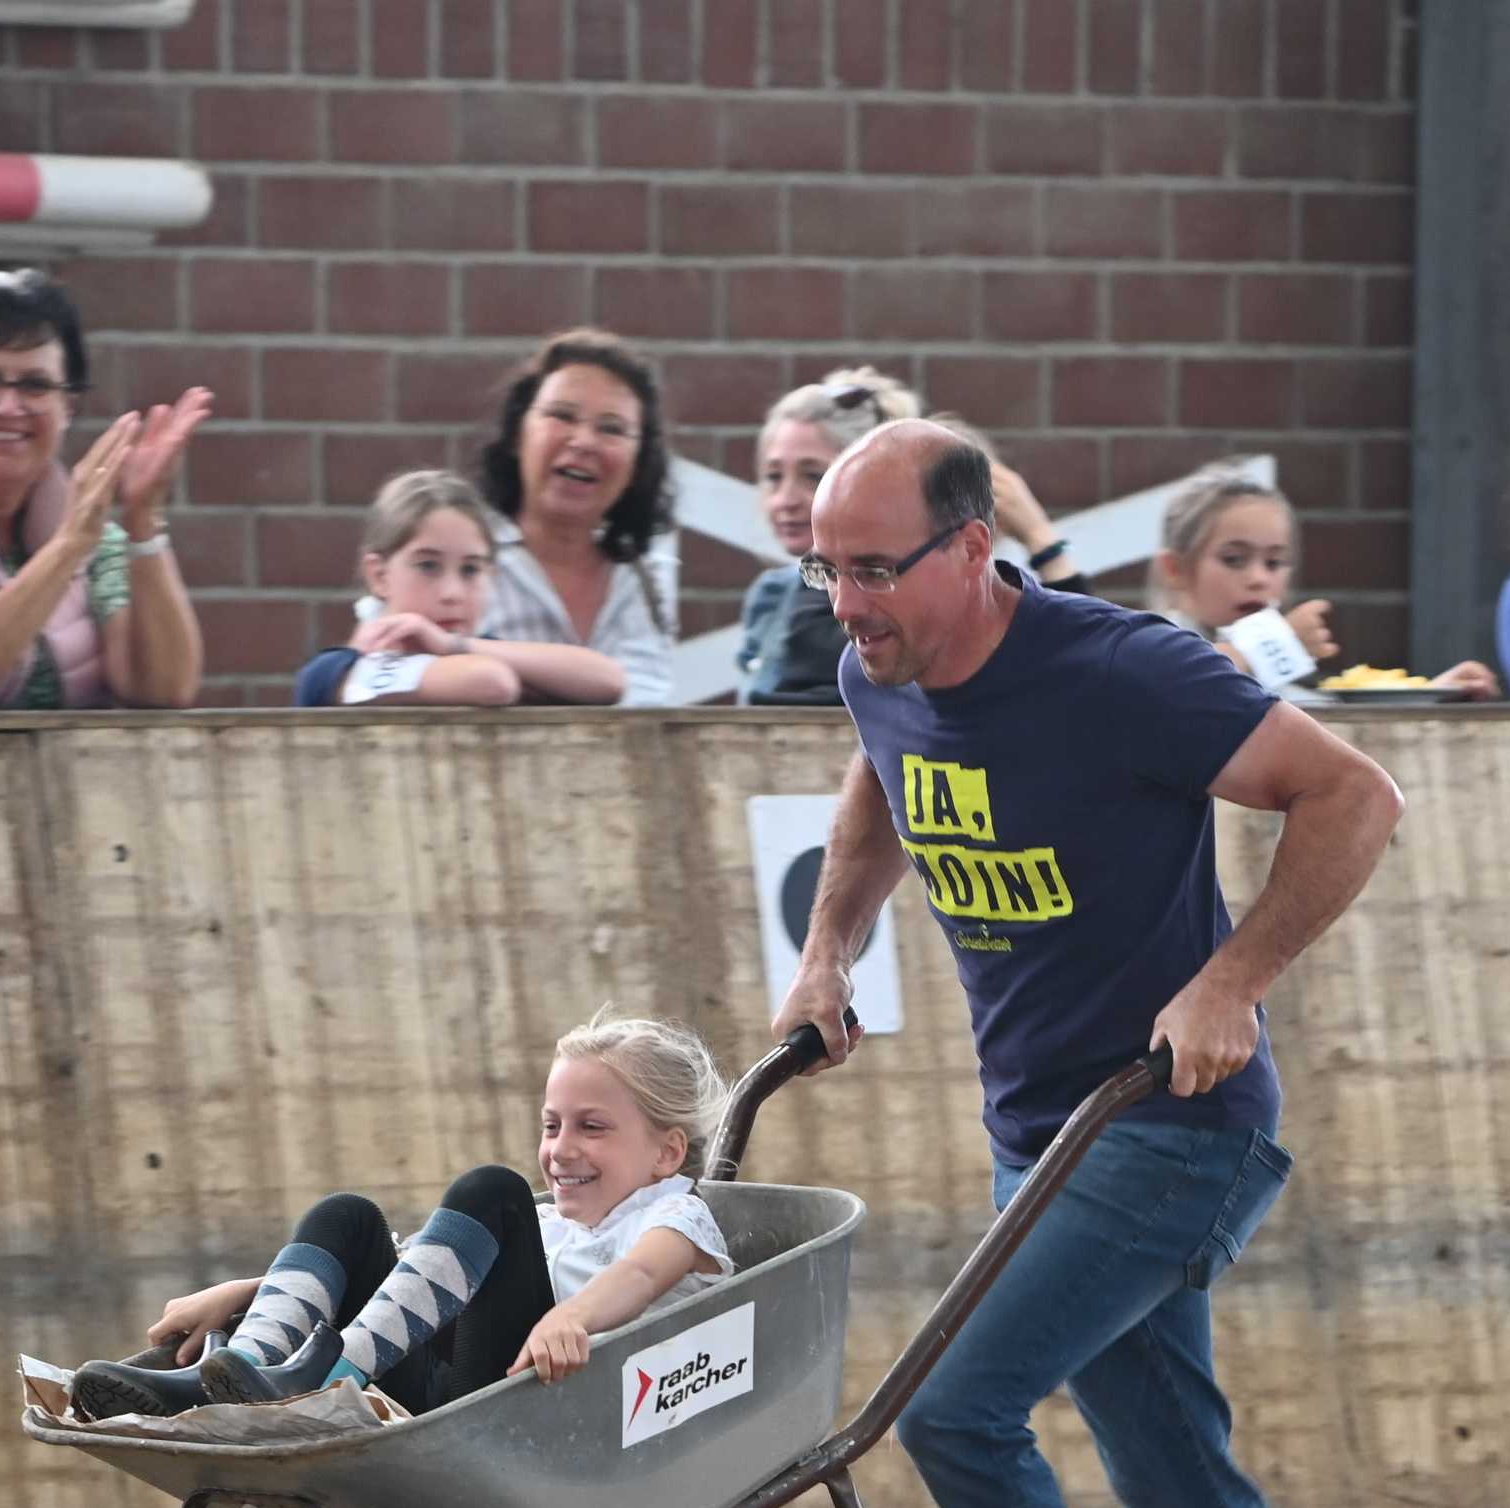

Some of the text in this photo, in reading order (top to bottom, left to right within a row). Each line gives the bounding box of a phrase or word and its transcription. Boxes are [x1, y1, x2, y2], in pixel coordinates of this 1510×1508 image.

[912, 767, 986, 831] JA,
[655, 1357, 748, 1413] karcher
[659, 1352, 711, 1391] raab
